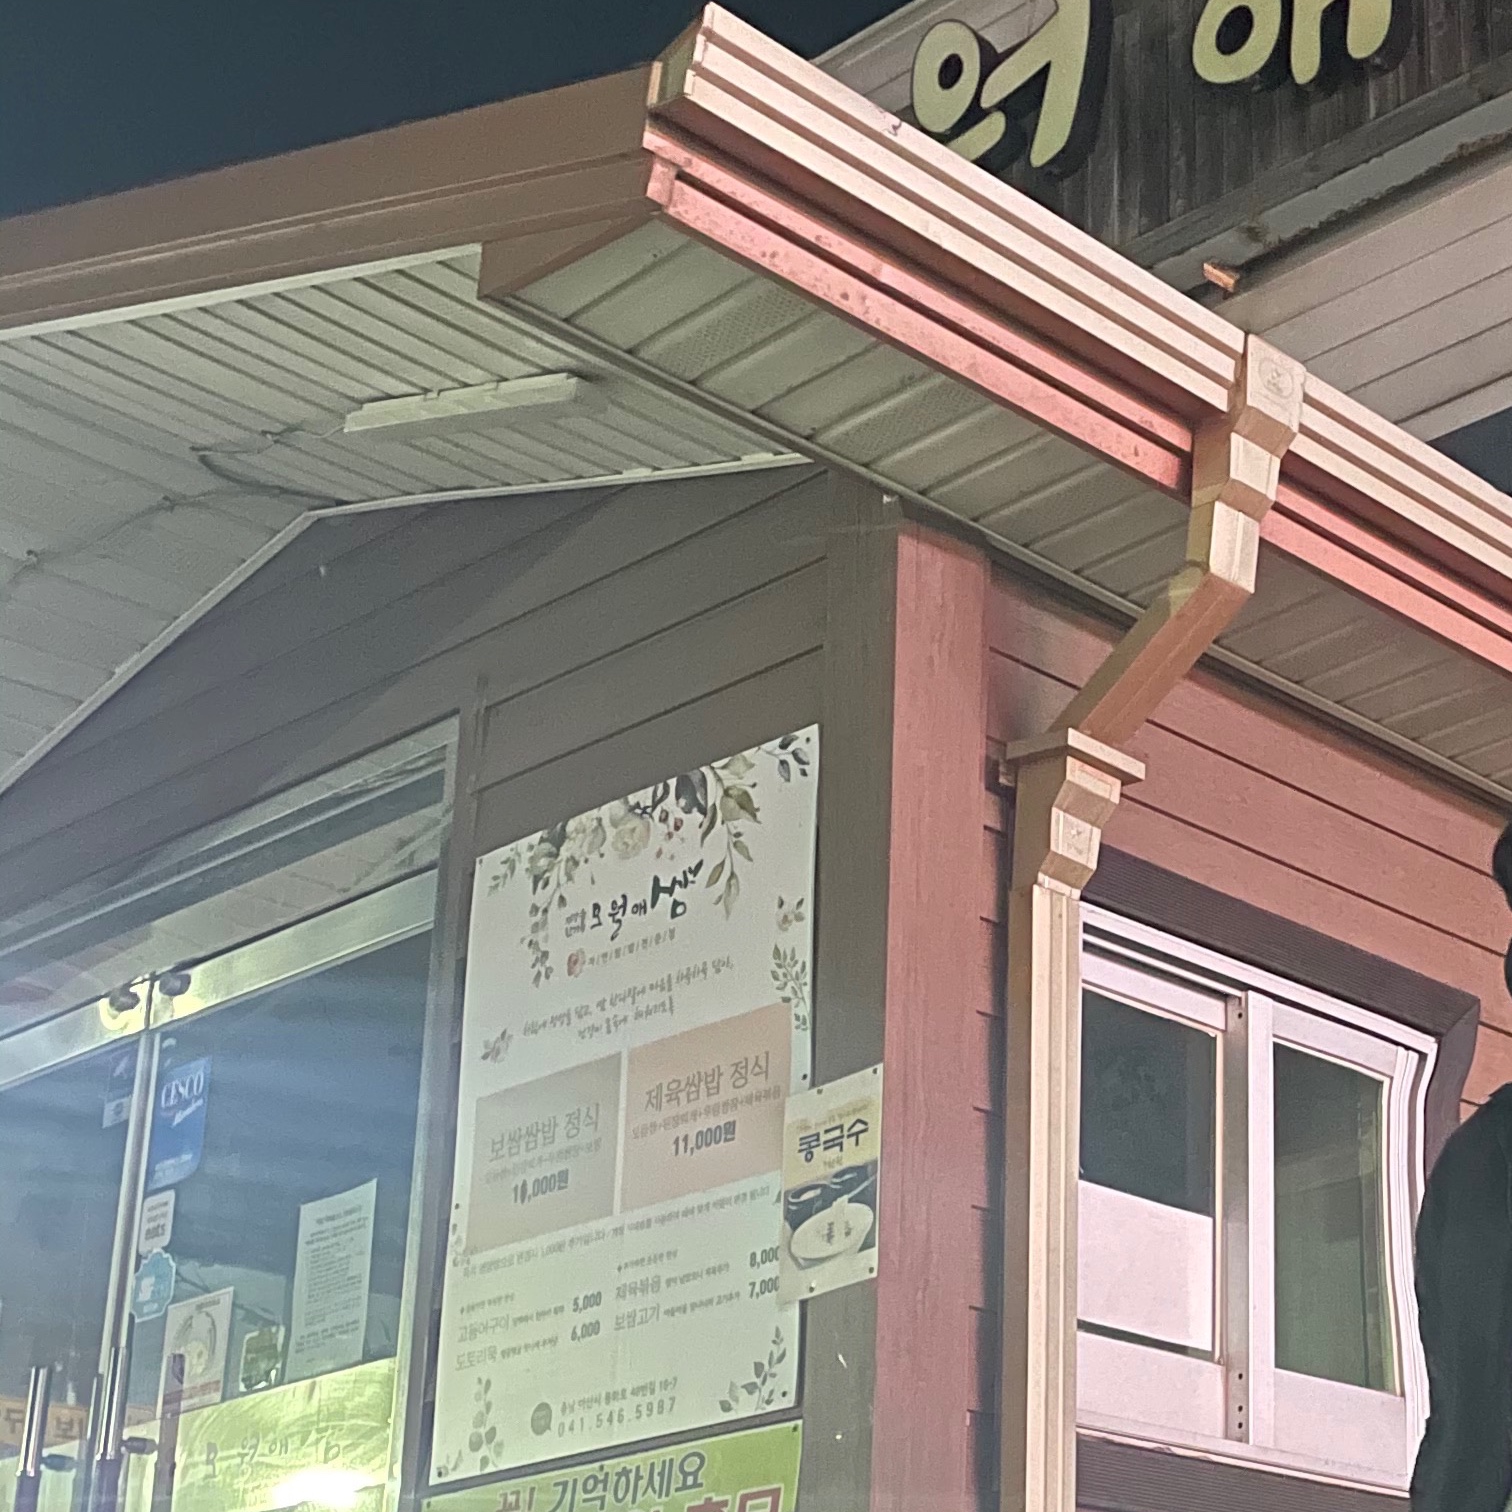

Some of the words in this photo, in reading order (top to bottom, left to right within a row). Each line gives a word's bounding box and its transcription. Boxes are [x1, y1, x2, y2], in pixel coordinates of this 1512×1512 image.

[644, 1068, 724, 1113] 제육쌈밥
[730, 1049, 769, 1083] 정식
[489, 1115, 559, 1163] 보쌈쌈밥
[563, 1102, 600, 1137] 정식
[672, 1120, 736, 1156] 11,000원
[798, 1118, 869, 1163] 콩국수
[571, 1290, 602, 1315] 5,000
[570, 1318, 601, 1343] 6,000
